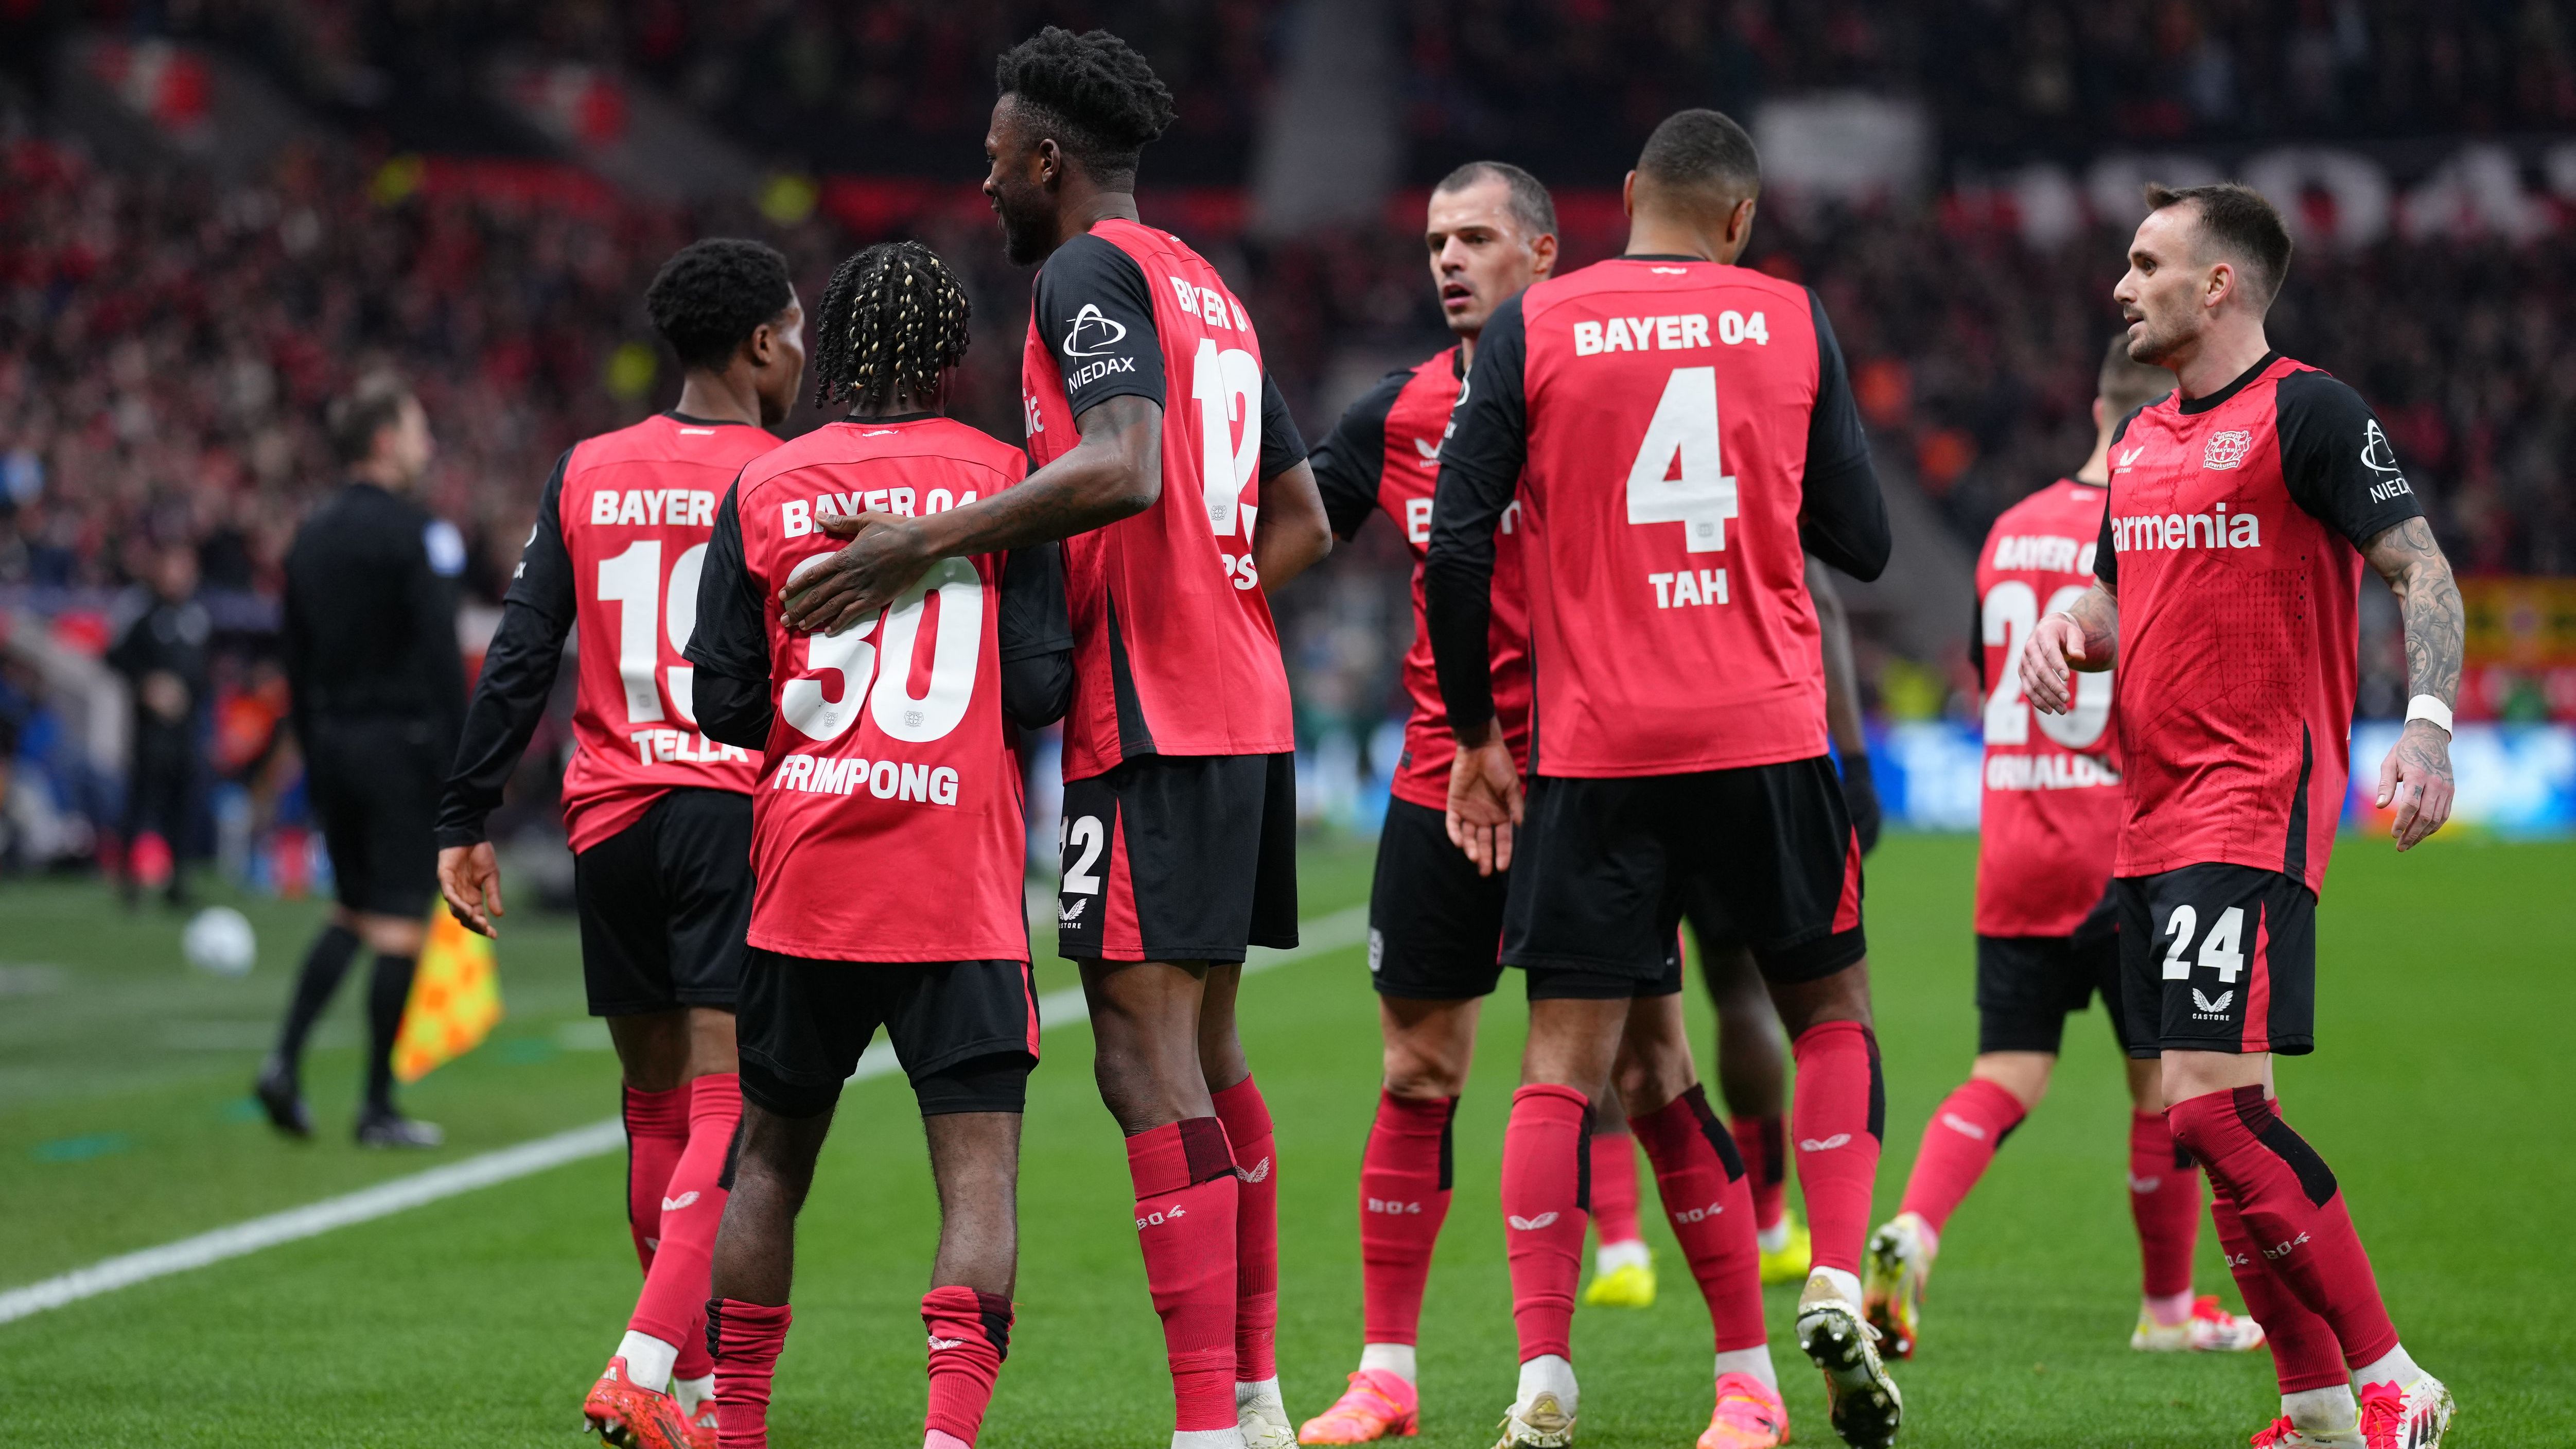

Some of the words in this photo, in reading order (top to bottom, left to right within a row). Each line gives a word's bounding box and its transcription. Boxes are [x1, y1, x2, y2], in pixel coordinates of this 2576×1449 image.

[1228, 298, 1251, 333] 0
[1573, 314, 1711, 356] BAYER
[1718, 310, 1768, 346] 04
[1068, 357, 1135, 394] NIEDAX
[1192, 338, 1262, 545] 12
[1626, 366, 1738, 553] 4
[591, 489, 715, 526] BAYER
[2370, 477, 2414, 504] NIED
[782, 487, 916, 538] BAYER
[2110, 502, 2260, 553] armenia
[1994, 535, 2078, 574] BAYER
[2077, 542, 2097, 577] 0
[1649, 568, 1728, 608] TAH
[781, 551, 983, 743] 30
[1982, 580, 2114, 749] 20
[630, 729, 749, 766] TELLA
[773, 754, 959, 806] FRIMPONG
[2163, 905, 2244, 983] 24
[2193, 1013, 2230, 1021] CASTORE
[1136, 1204, 1187, 1231] B04
[2225, 1253, 2249, 1267] 04
